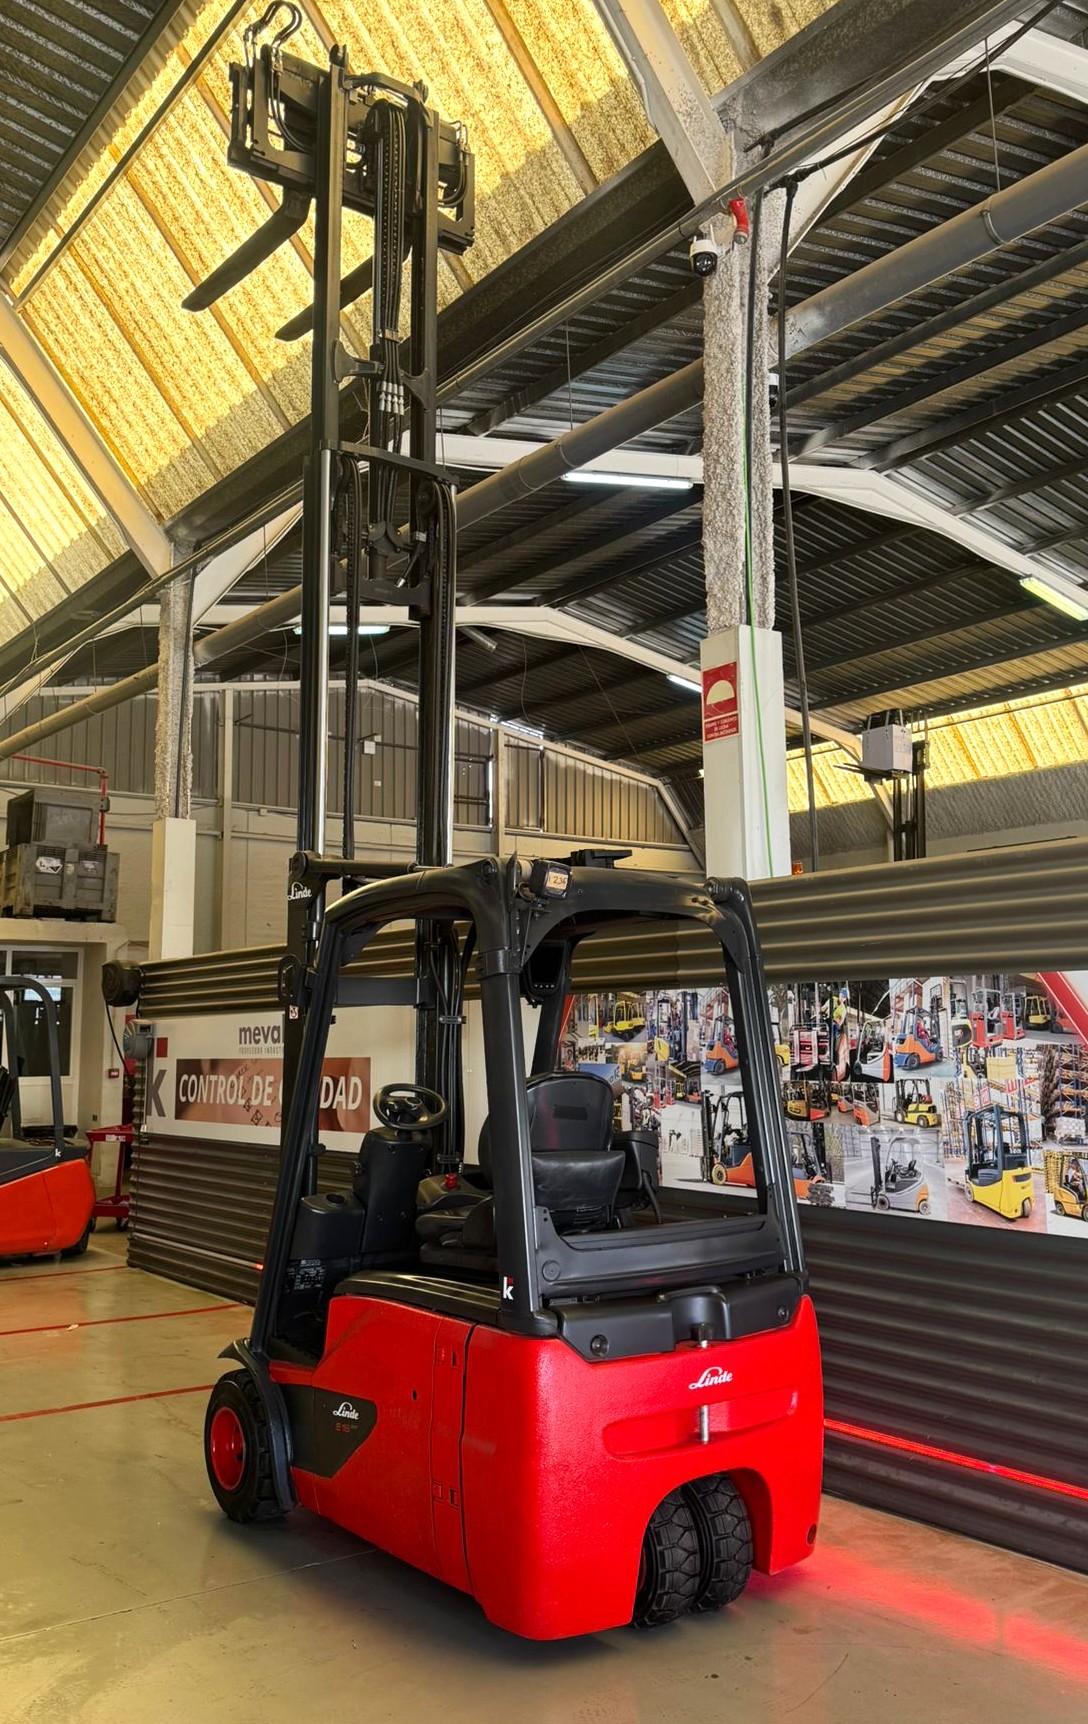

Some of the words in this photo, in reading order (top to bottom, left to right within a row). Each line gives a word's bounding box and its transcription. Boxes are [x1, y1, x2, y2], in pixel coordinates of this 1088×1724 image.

[287, 882, 312, 900] Linde
[180, 1074, 246, 1106] CONTROL
[250, 1075, 275, 1107] DE
[503, 1276, 514, 1300] k
[689, 1366, 733, 1390] Linde
[333, 1402, 359, 1420] Linde
